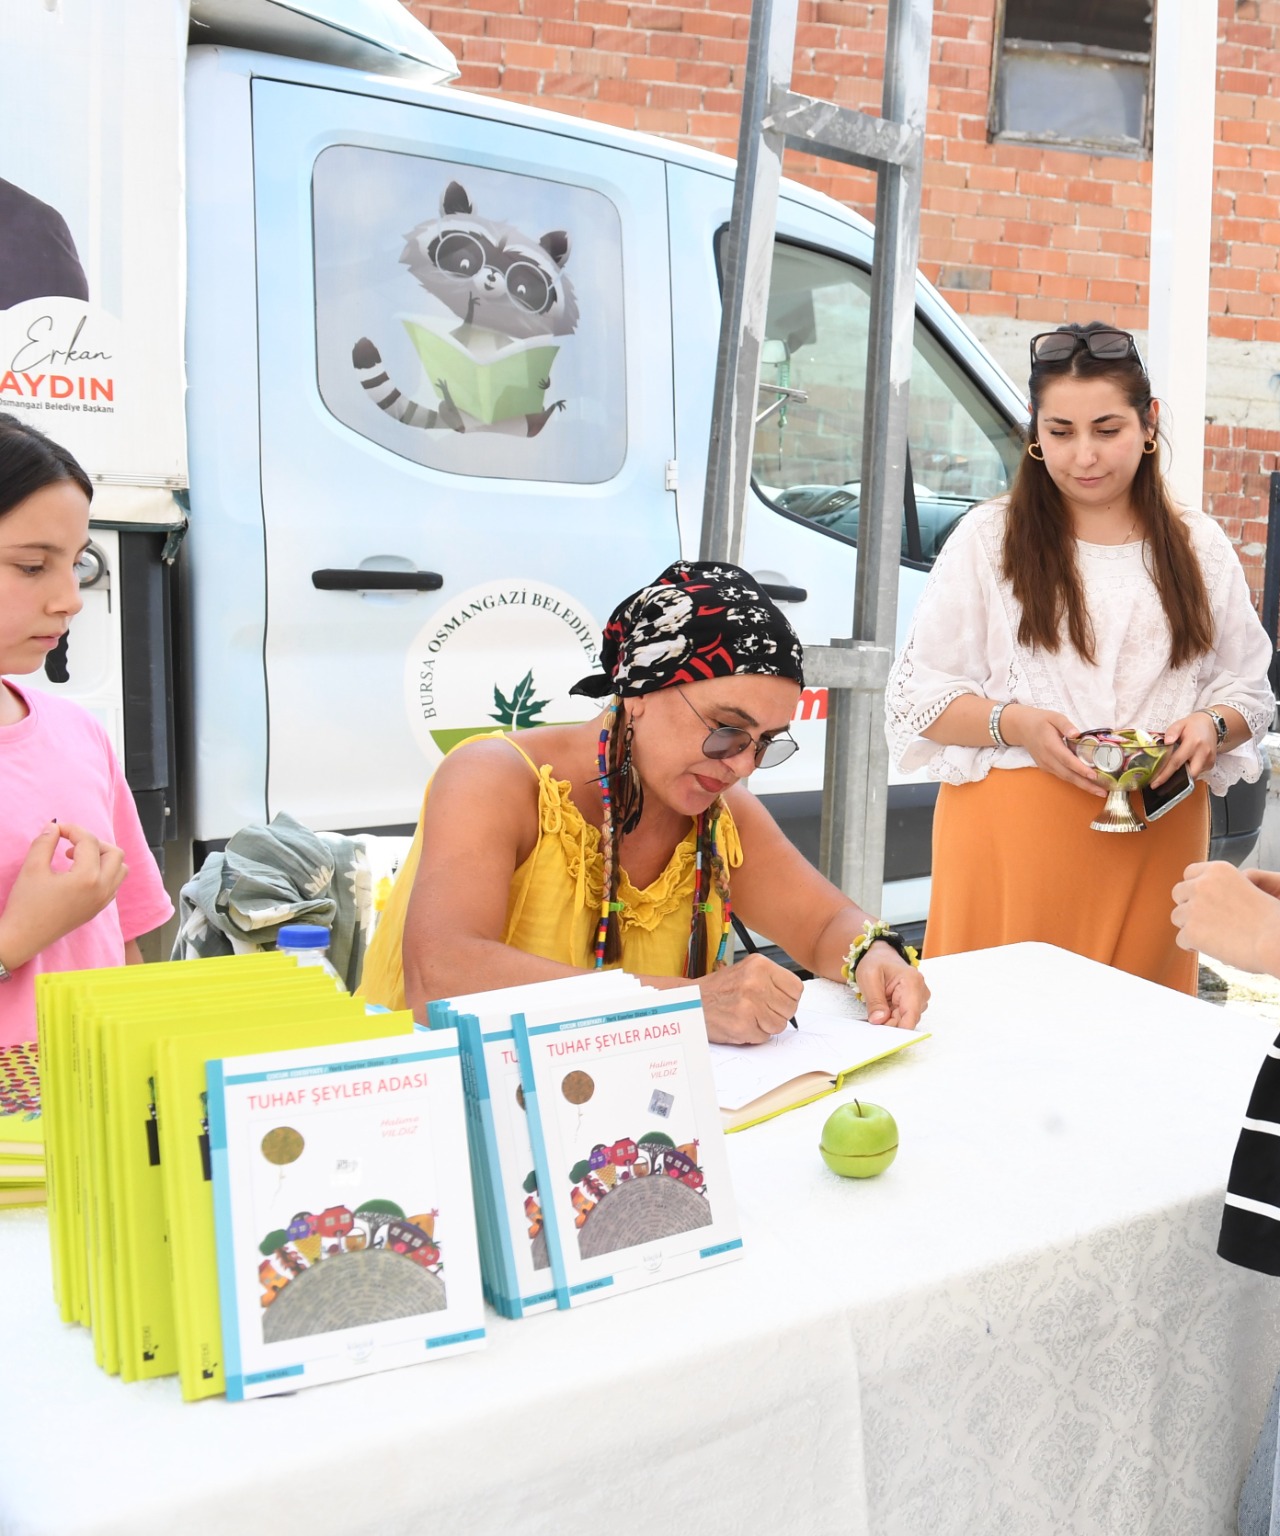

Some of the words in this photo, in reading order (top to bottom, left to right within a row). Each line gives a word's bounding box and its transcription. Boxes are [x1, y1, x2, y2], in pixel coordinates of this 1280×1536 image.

[11, 315, 112, 373] Erkan
[0, 371, 114, 401] AYDIN
[45, 402, 80, 412] Belediye
[83, 404, 114, 413] Başkanı
[428, 588, 527, 653] OSMANGAZİ
[420, 659, 437, 719] BURSA
[546, 1038, 591, 1057] TUHAF
[595, 1029, 641, 1052] ŞEYLER
[644, 1022, 681, 1041] ADASI
[247, 1089, 306, 1111] TUHAF
[312, 1080, 372, 1106] ŞEYLER
[377, 1073, 428, 1093] ADASI
